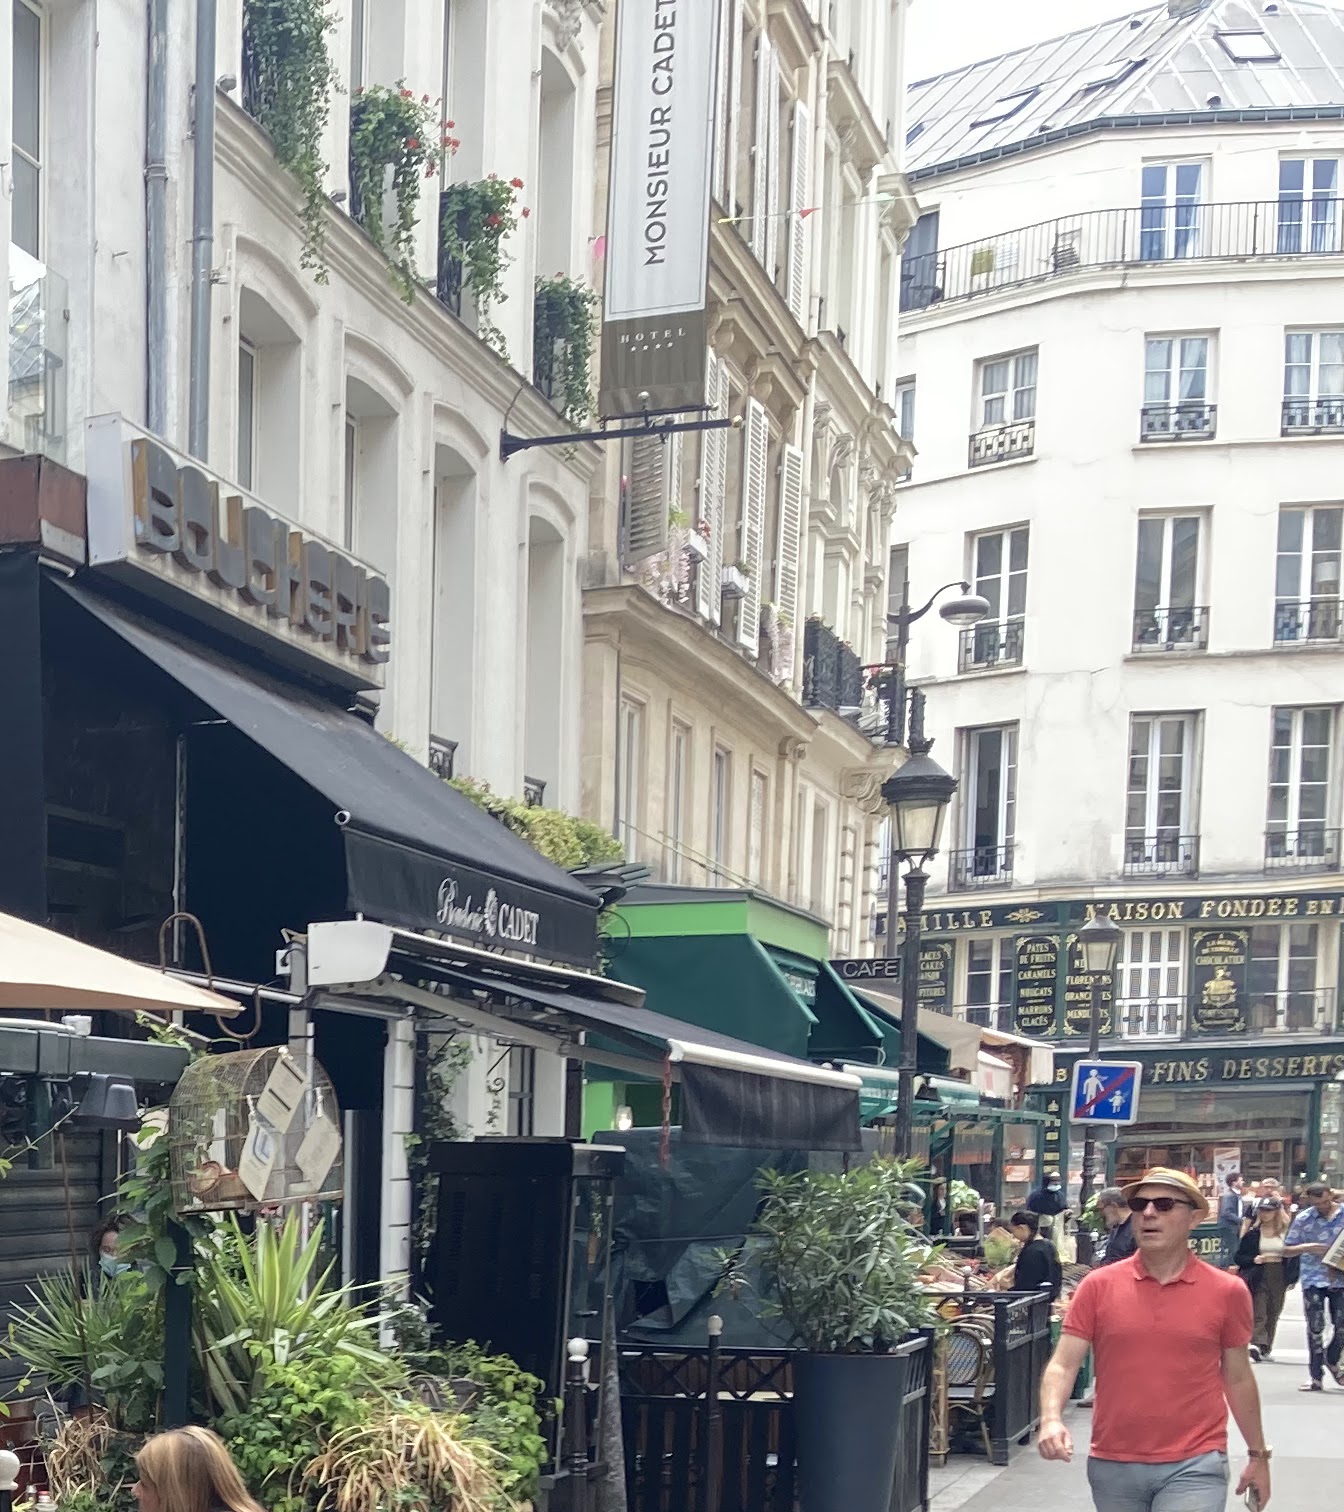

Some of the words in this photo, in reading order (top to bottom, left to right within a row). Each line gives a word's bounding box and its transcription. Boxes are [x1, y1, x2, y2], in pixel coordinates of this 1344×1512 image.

[651, 0, 679, 96] CADET
[644, 104, 673, 267] MONSIEUR
[620, 327, 687, 344] HOTEL
[131, 438, 391, 665] BOUCHERIE
[1084, 901, 1185, 921] MAISON
[1305, 899, 1334, 916] EN
[498, 903, 540, 945] CADET
[920, 960, 945, 971] CAKES
[1030, 953, 1056, 963] FRUITS
[842, 959, 898, 978] CAFE
[1017, 968, 1057, 980] CARAMELS
[1019, 986, 1053, 998] NOUGATS
[1017, 1004, 1054, 1016] MARRONS
[1151, 1057, 1210, 1085] FINS
[1221, 1053, 1344, 1080] DESSERTS
